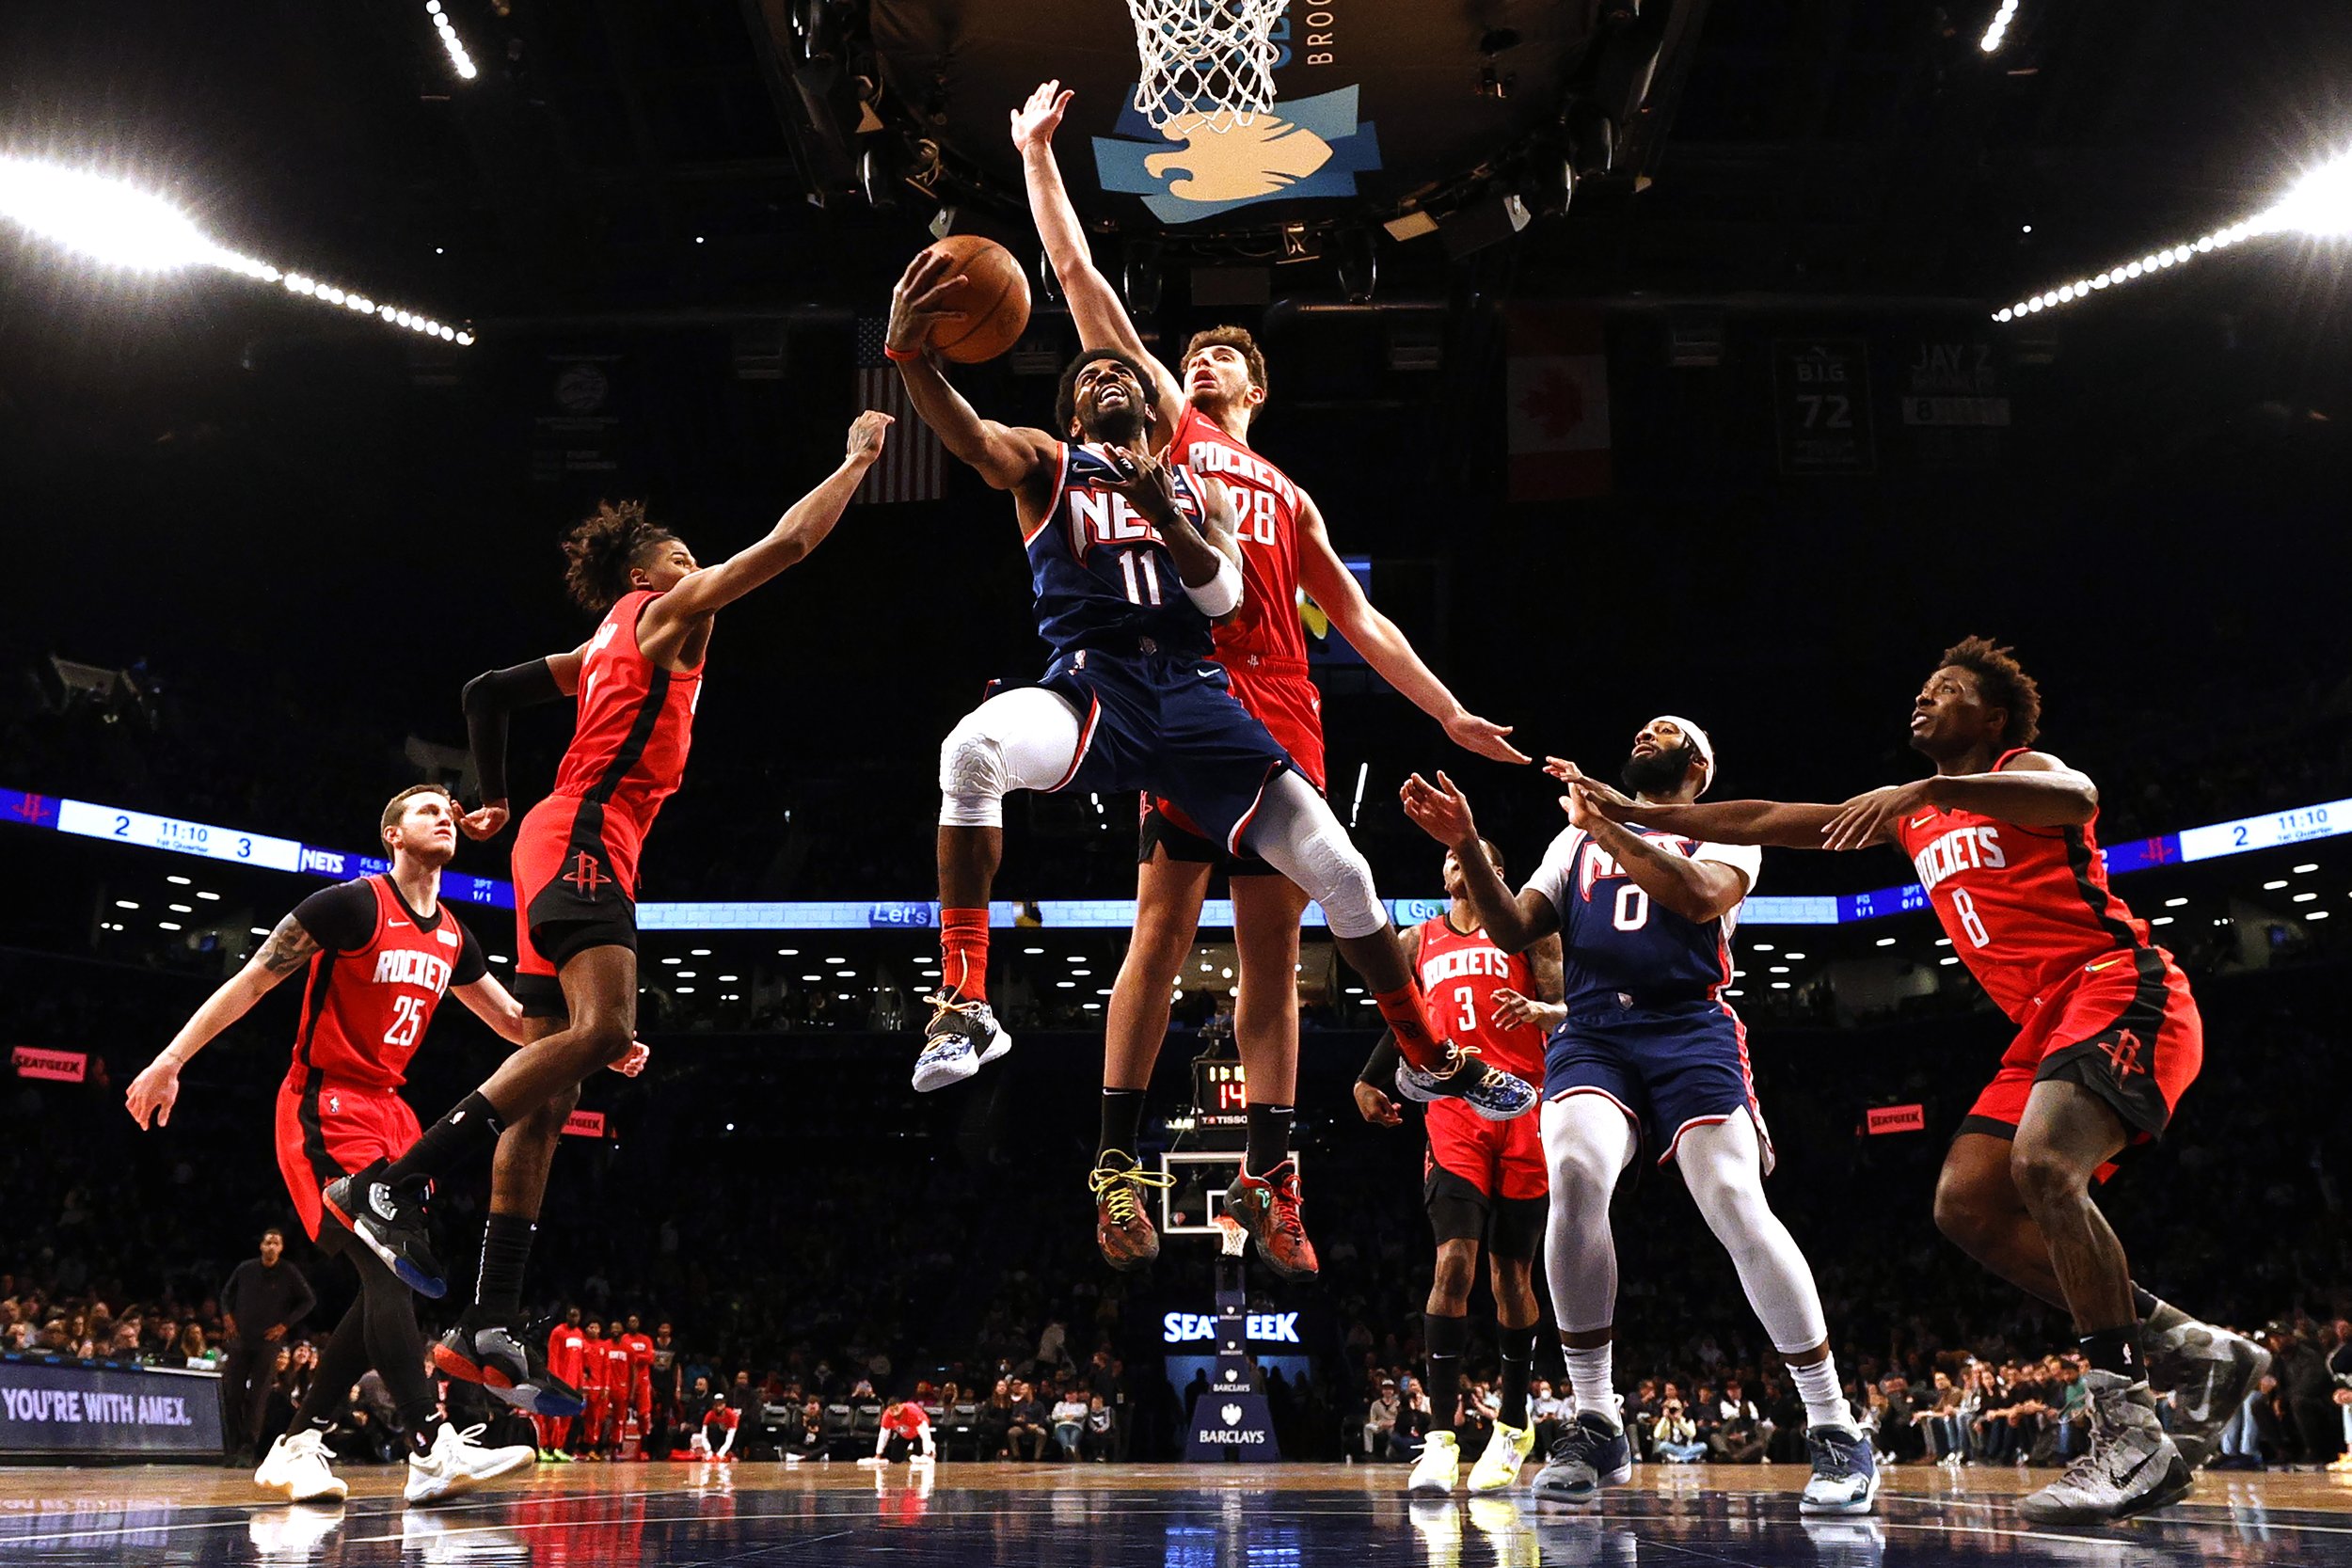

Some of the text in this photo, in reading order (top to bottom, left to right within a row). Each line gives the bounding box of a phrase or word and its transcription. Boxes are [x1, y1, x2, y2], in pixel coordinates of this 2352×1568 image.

[1795, 394, 1851, 428] 72
[1188, 441, 1295, 510] ROCKETS
[1067, 485, 1197, 568] NE
[1229, 486, 1276, 546] 28
[1119, 548, 1163, 607] 11
[114, 816, 130, 836] 2
[2278, 808, 2328, 830] 11:10
[161, 821, 209, 843] 11:10
[2233, 826, 2249, 847] 2
[237, 838, 251, 858] 3
[300, 848, 345, 873] NETS
[472, 891, 491, 903] 1/1
[1411, 899, 1438, 919] Go
[1613, 883, 1650, 933] 0
[1901, 896, 1923, 910] 0/0
[873, 903, 928, 926] Let's
[1856, 906, 1874, 917] 1/1
[1951, 887, 1990, 949] 8
[1422, 946, 1509, 988] ROCKETS
[383, 995, 426, 1046] 25
[1454, 986, 1477, 1032] 3
[1220, 1084, 1247, 1109] 14
[1216, 1115, 1248, 1124] TISSO
[1870, 1111, 1920, 1129] SEATGEEK
[1164, 1312, 1299, 1342] SEAEEK
[1213, 1384, 1250, 1392] BARCLAYS
[1, 1387, 192, 1426] YOU'RE WITH AMEX.
[1200, 1430, 1265, 1444] BARCLAYS
